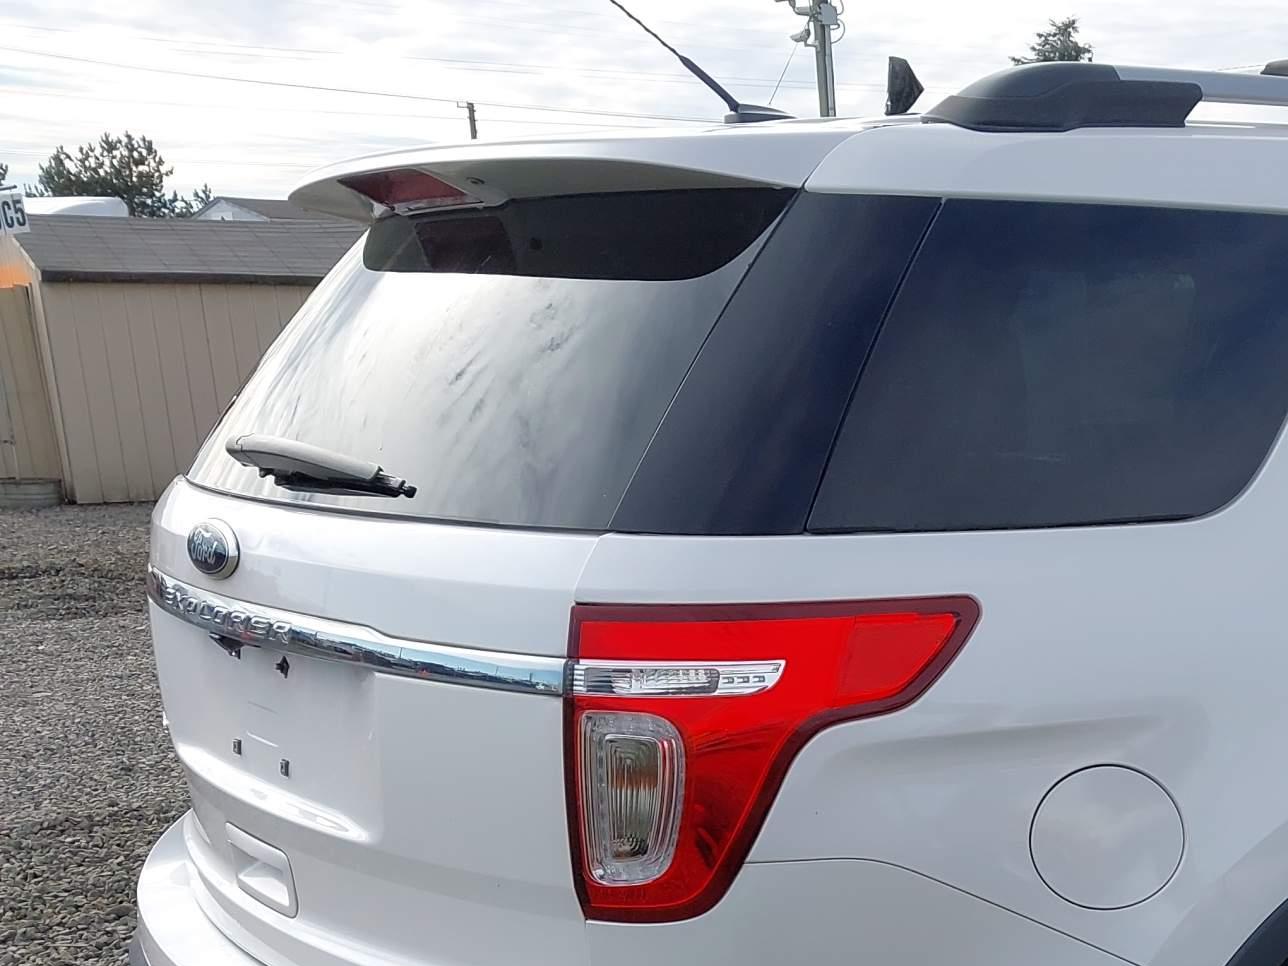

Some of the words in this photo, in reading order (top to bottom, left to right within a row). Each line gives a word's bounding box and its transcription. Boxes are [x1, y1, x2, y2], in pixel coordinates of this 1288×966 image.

[0, 199, 27, 229] C5
[189, 528, 219, 566] Ford
[164, 586, 292, 645] EXPLORER
